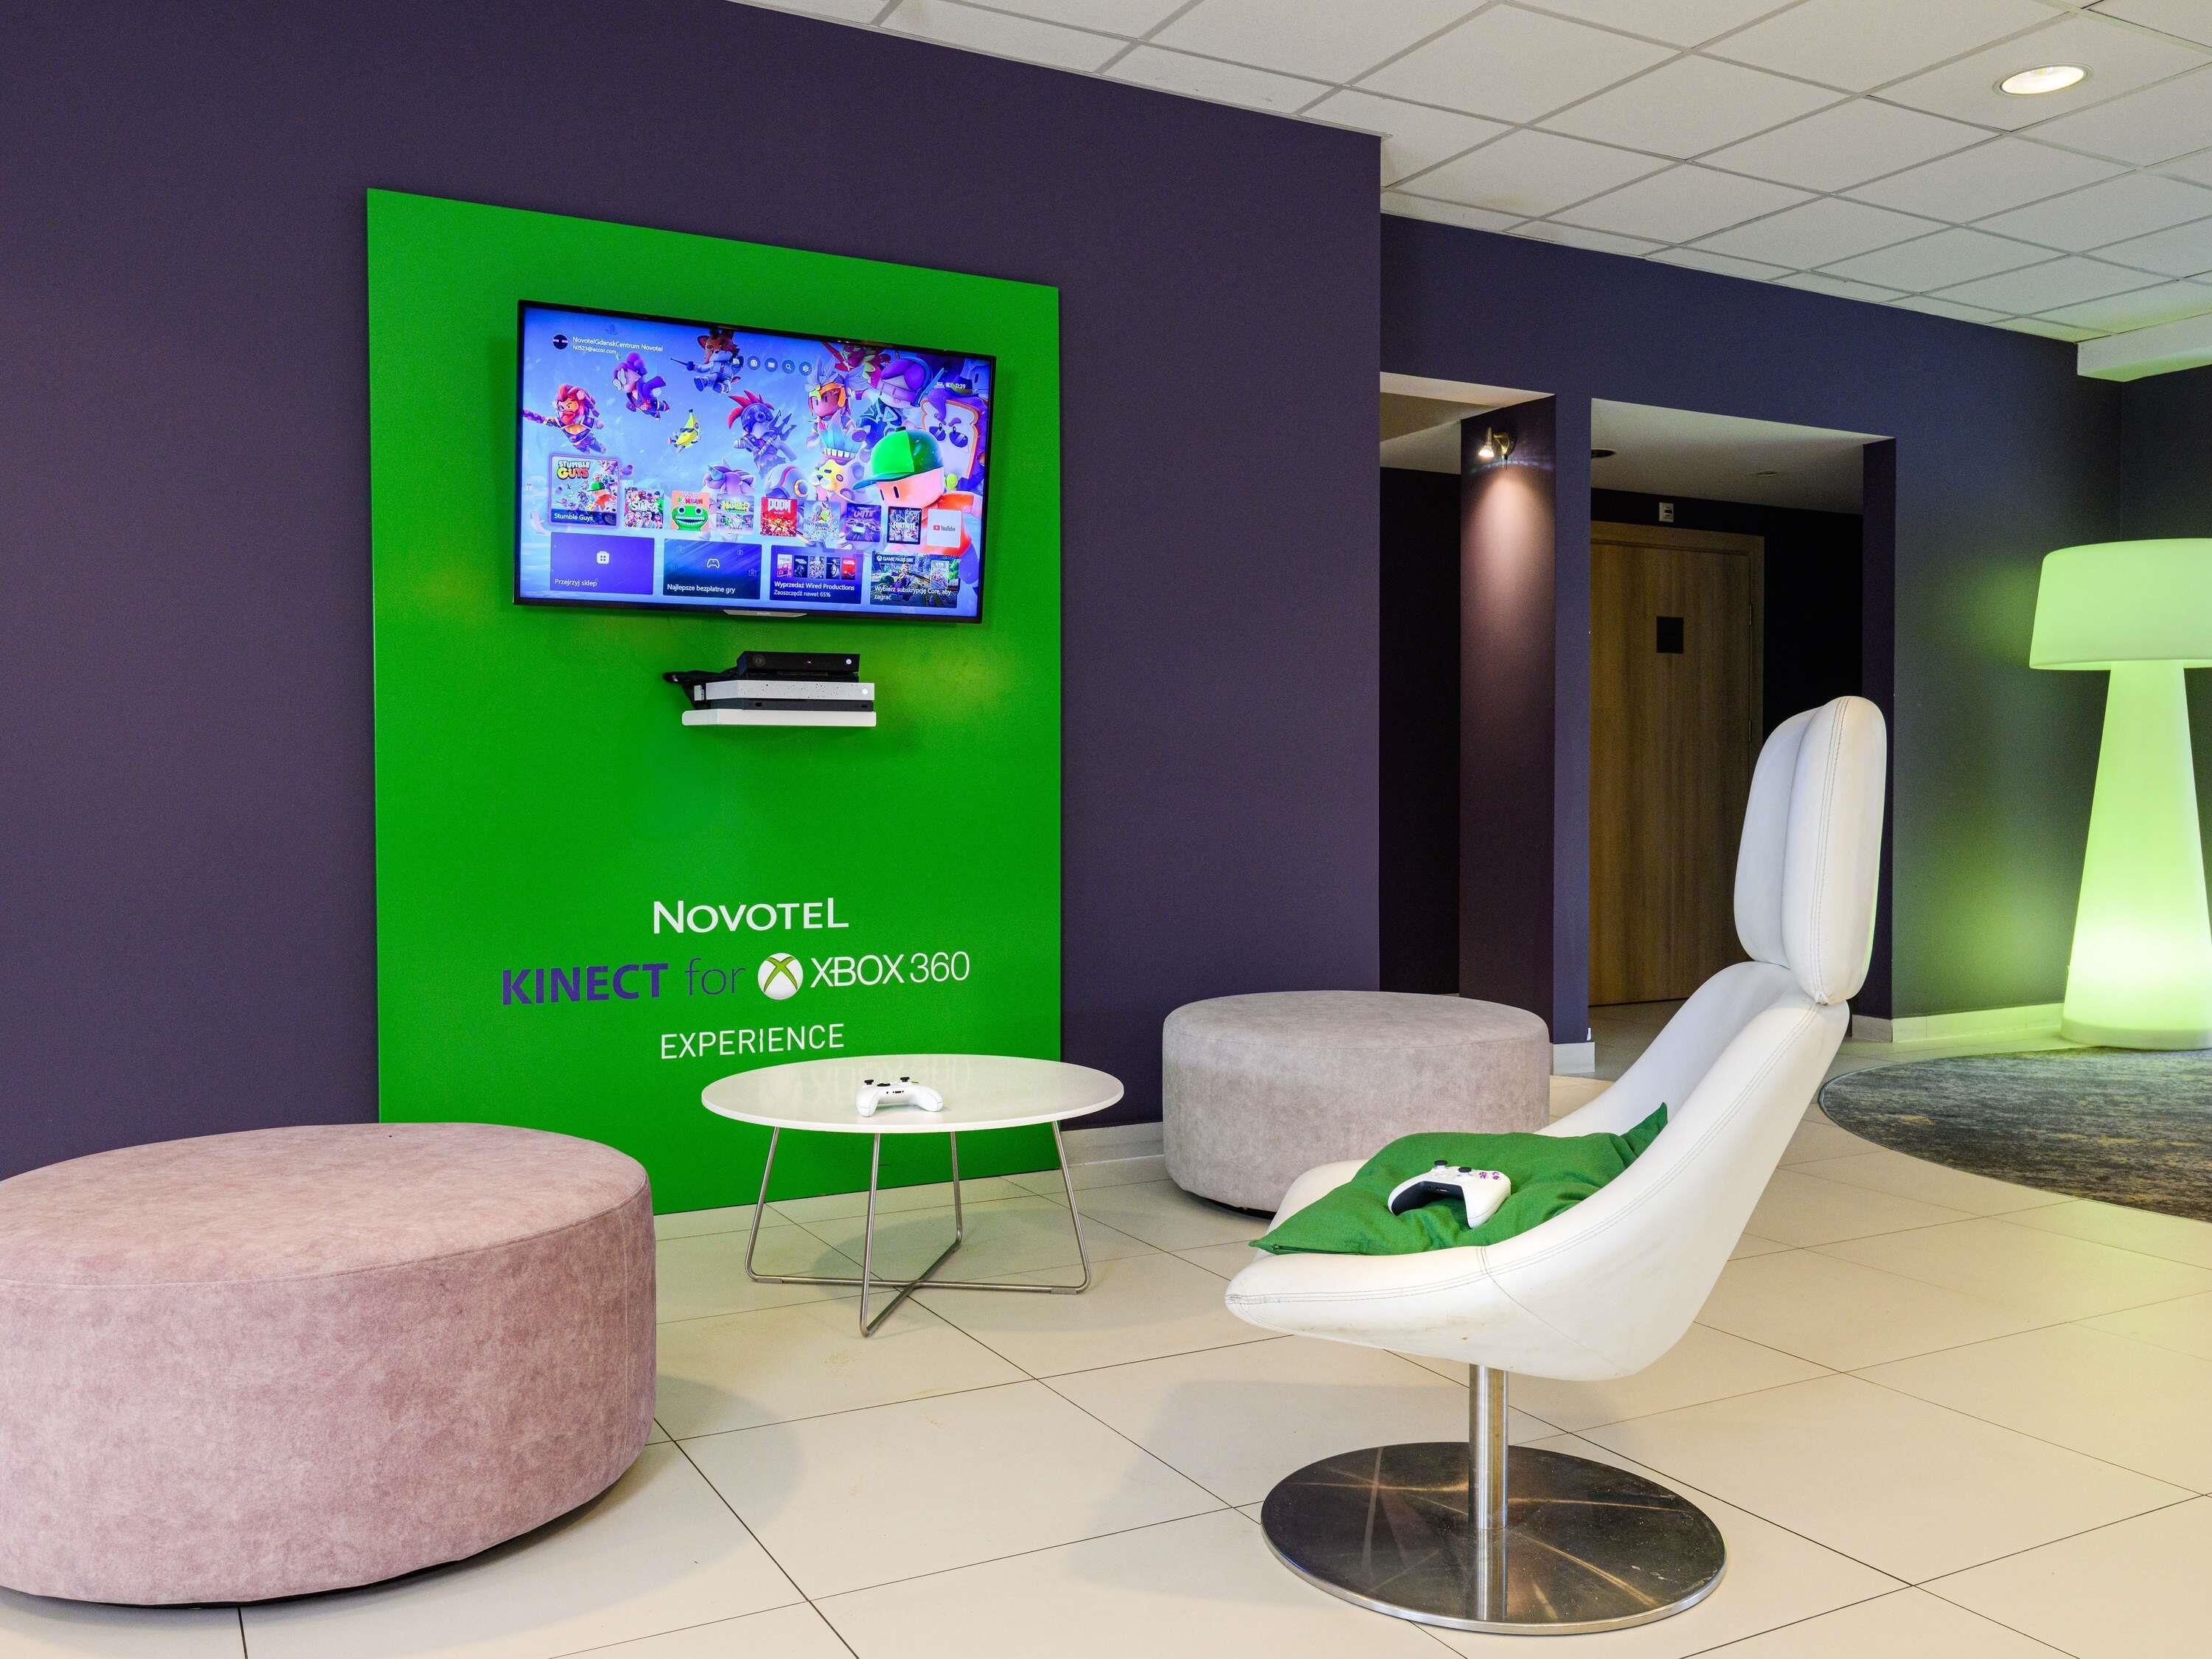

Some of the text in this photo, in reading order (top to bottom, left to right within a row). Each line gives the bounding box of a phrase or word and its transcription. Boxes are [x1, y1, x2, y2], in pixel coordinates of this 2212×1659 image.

[573, 337, 663, 352] NovotelGdanskCentrum Novotel
[558, 460, 591, 468] STUMBLE
[557, 467, 588, 480] GUYS
[554, 578, 580, 587] Przejrzyj
[667, 583, 695, 592] Najlepsze
[503, 951, 970, 1006] KINECT for XBOX 360
[661, 1023, 845, 1060] EXPERIENCE
